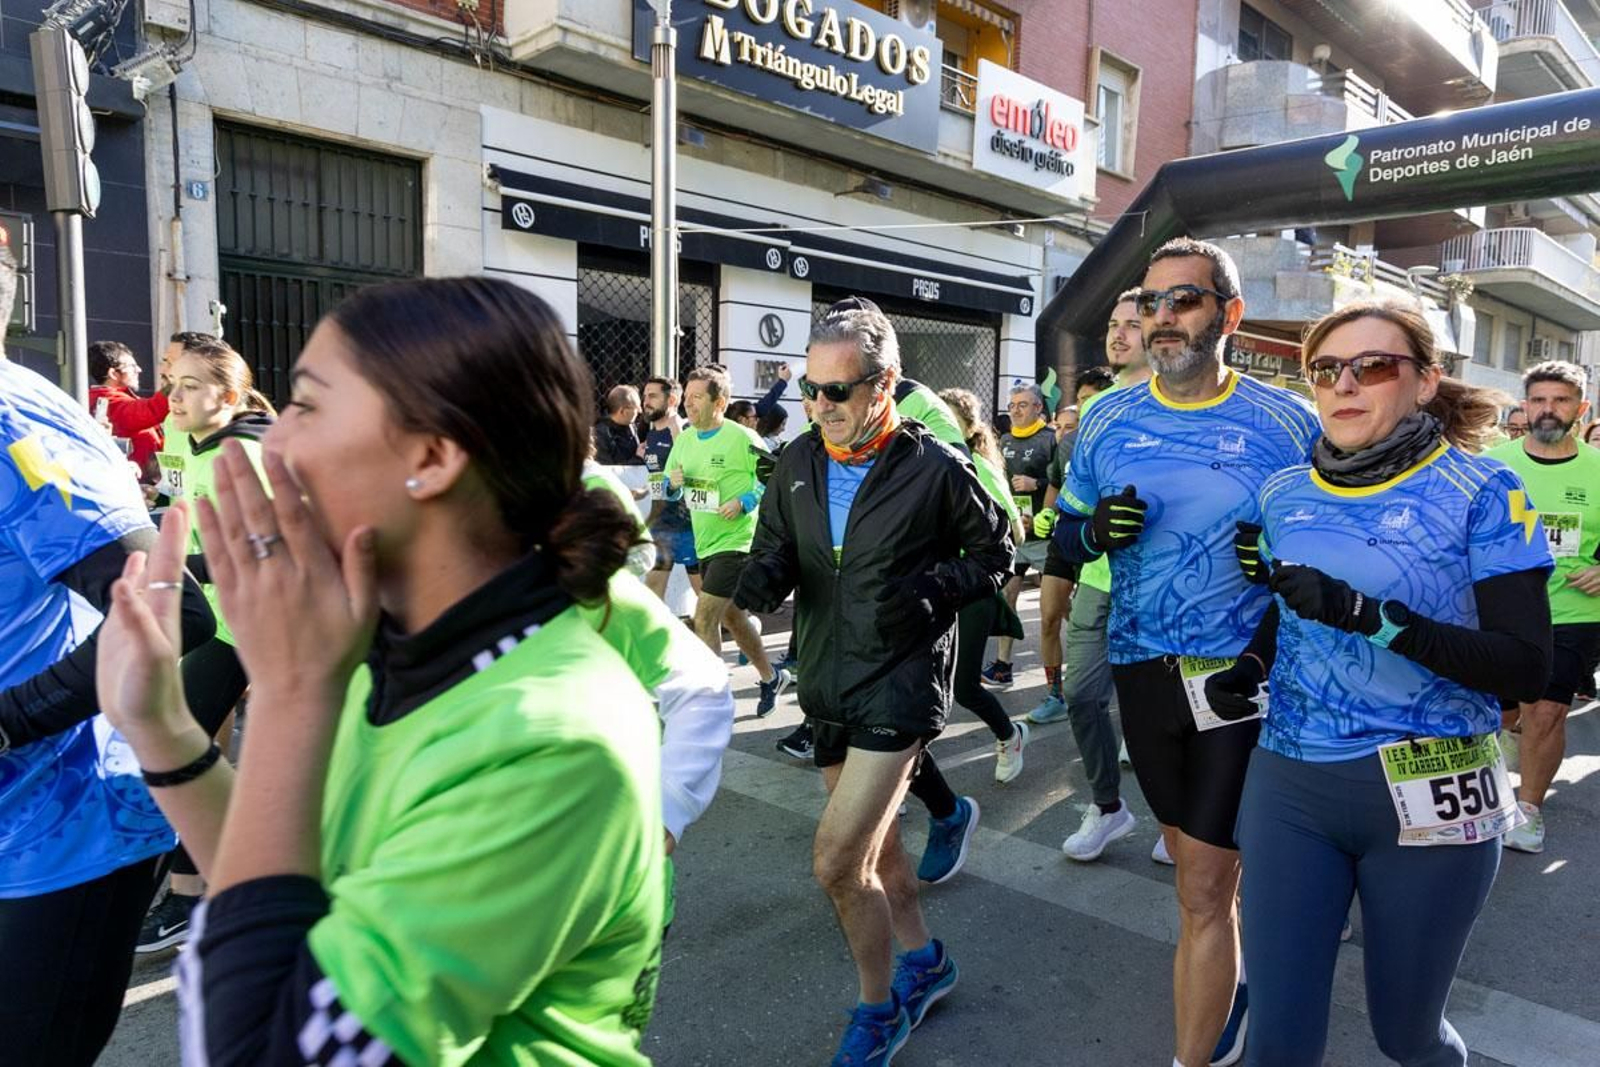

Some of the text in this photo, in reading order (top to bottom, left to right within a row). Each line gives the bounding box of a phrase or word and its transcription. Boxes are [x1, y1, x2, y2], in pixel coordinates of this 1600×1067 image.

[705, 0, 931, 86] OGADOS
[1369, 116, 1592, 164] Patronato Municipal de
[1369, 146, 1533, 182] Deportes de Jaén
[191, 182, 204, 200] 6
[690, 489, 708, 504] 214
[1397, 762, 1406, 775] IV
[1409, 756, 1449, 775] CARRERA
[1428, 766, 1500, 822] 550
